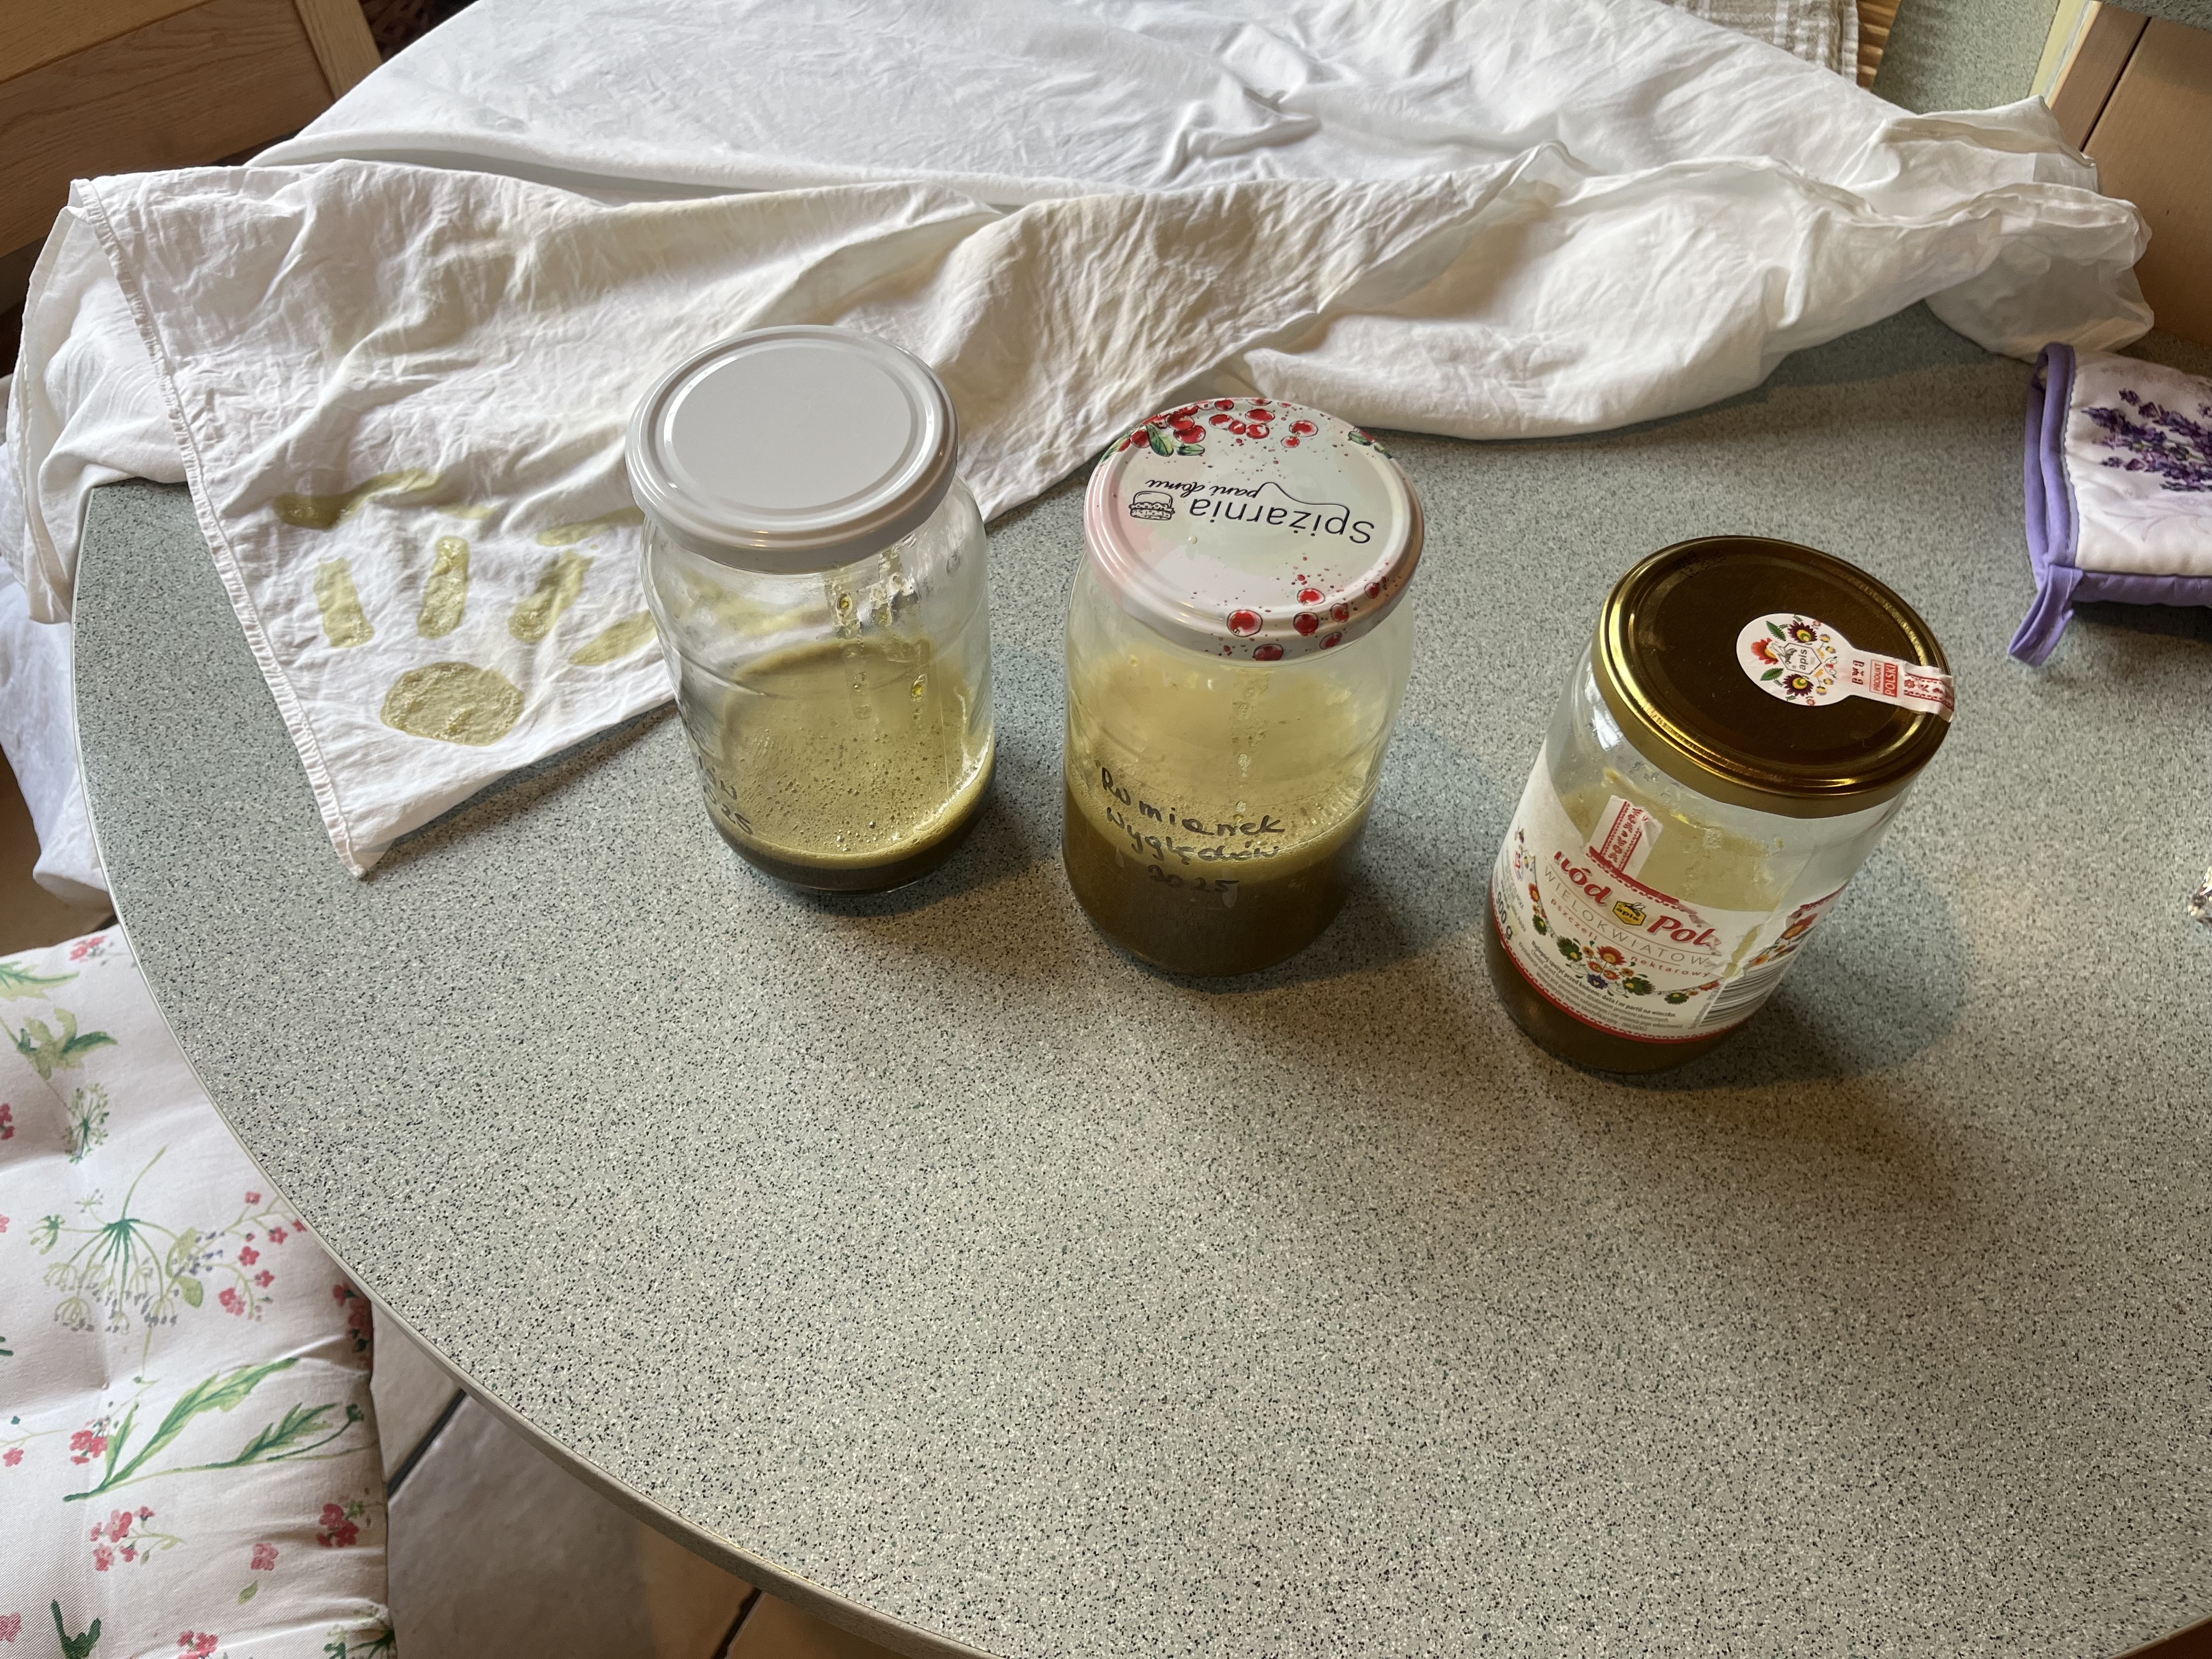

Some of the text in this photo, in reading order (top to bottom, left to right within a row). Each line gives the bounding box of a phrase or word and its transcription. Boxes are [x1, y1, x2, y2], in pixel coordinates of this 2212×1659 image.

[1144, 479, 1261, 499] pani domu
[1189, 498, 1375, 544] Spiżarnia
[1798, 649, 1809, 670] apis
[1873, 662, 1882, 692] PRODUKT
[1884, 663, 1897, 696] POLSKI
[1147, 864, 1240, 893] 2025
[1496, 891, 1507, 924] 900
[1544, 865, 1712, 966] WIELOKWIATOW
[1616, 907, 1639, 922] apis
[1551, 898, 1711, 978] pszczeli nektarowy
[1564, 973, 1579, 985] przed
[1602, 995, 1615, 1003] data
